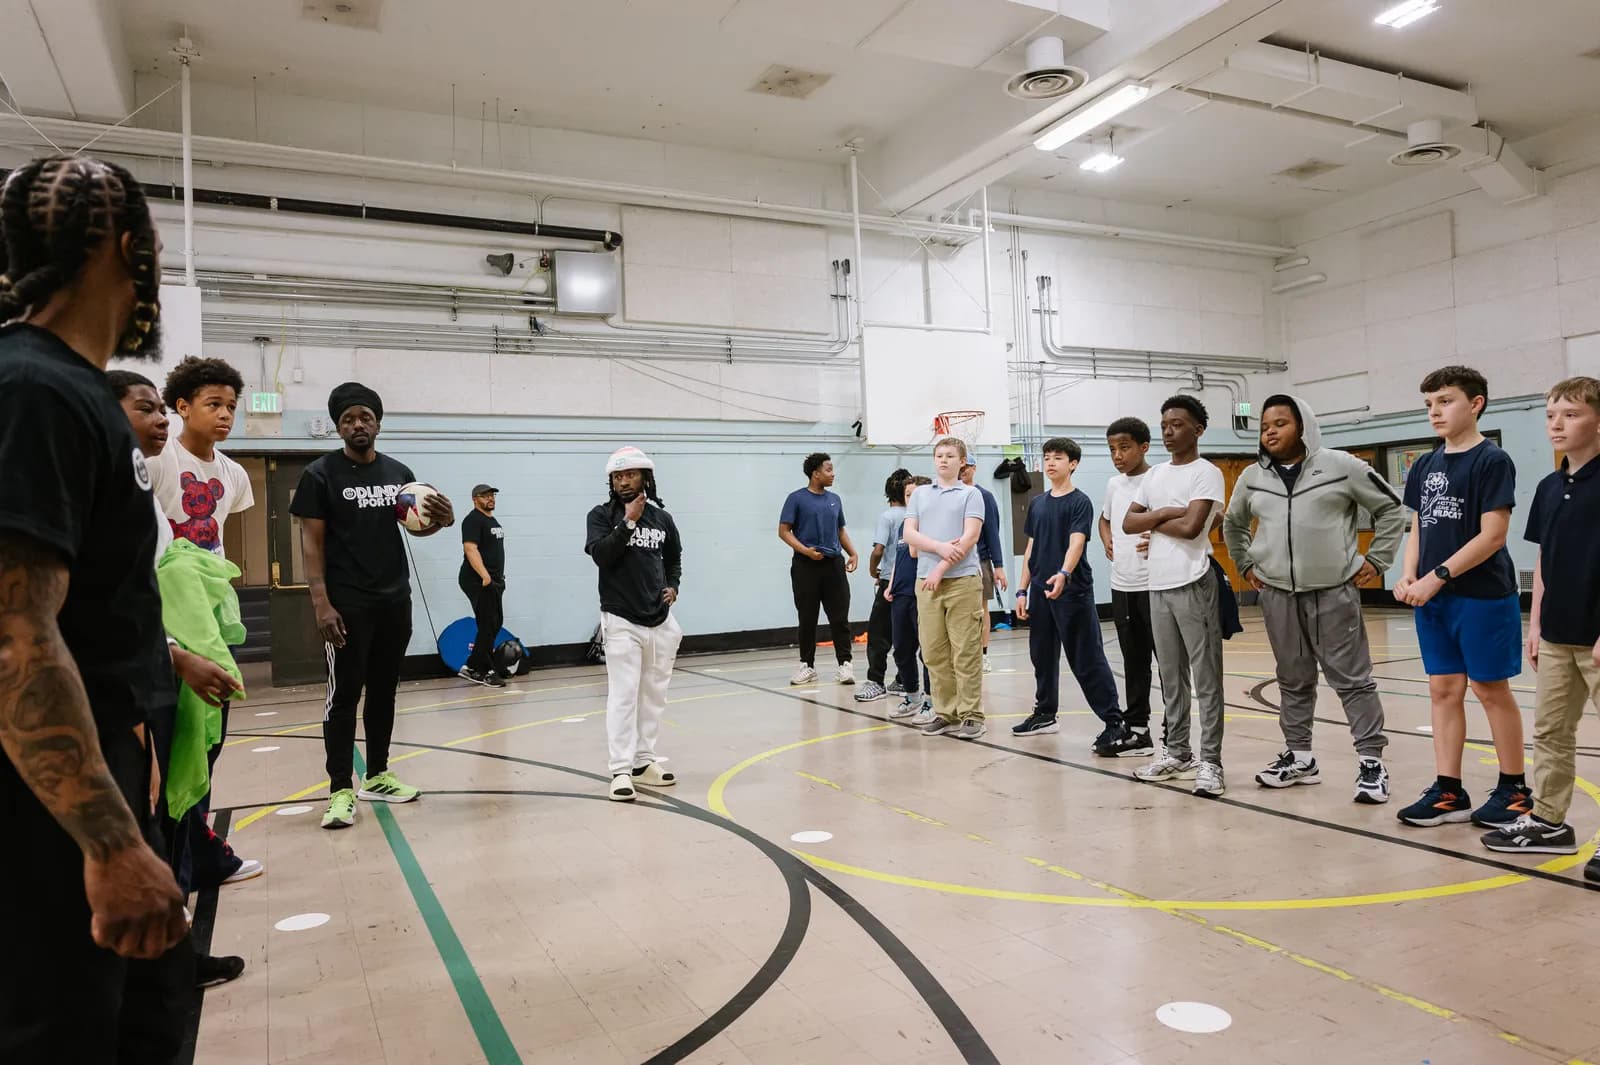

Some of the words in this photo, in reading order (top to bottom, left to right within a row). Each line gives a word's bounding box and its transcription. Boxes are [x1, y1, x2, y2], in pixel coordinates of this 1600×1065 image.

[252, 392, 278, 411] EXIT
[358, 496, 397, 508] SPORTS
[1432, 510, 1464, 520] WILDCAT
